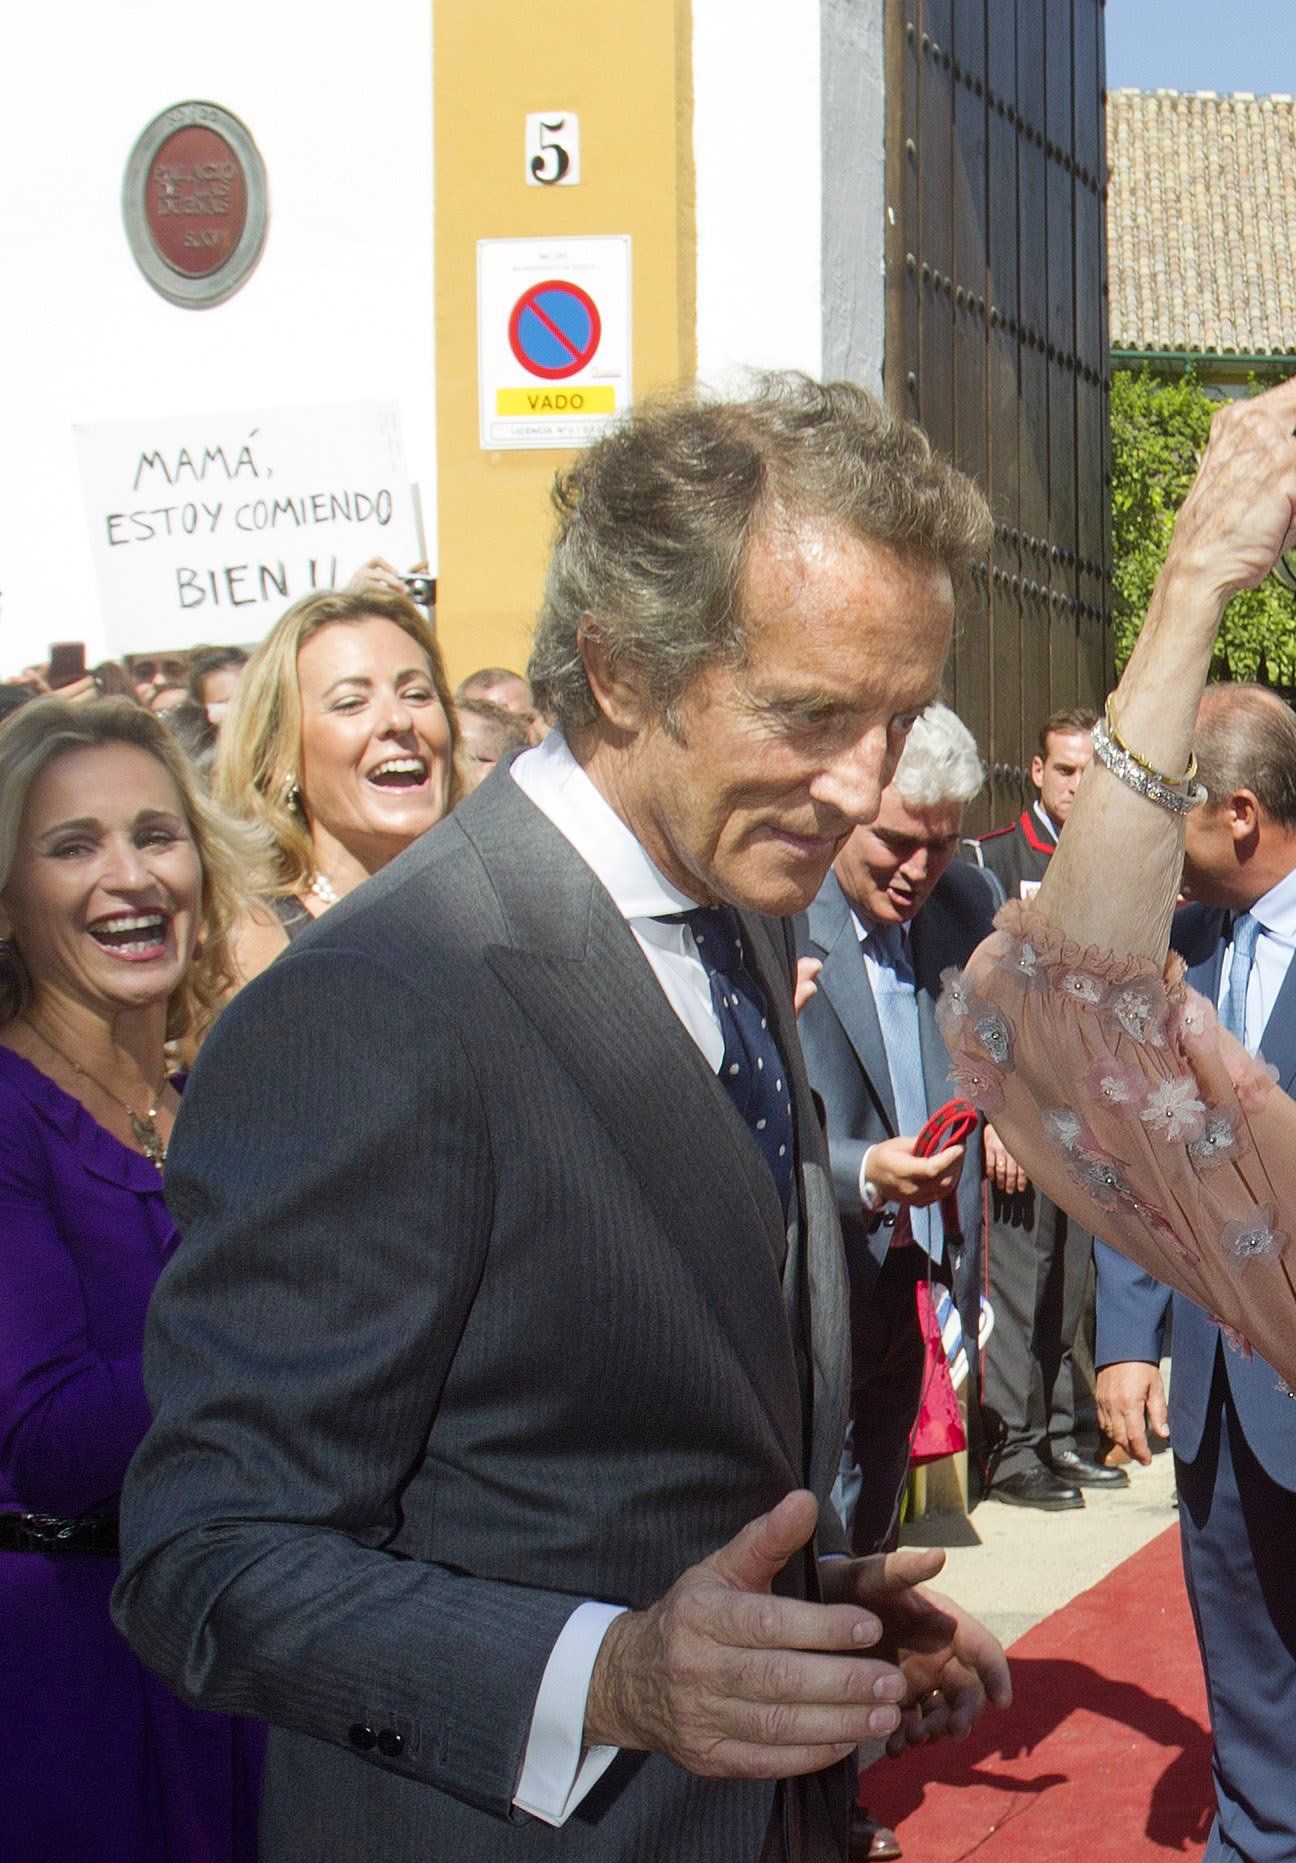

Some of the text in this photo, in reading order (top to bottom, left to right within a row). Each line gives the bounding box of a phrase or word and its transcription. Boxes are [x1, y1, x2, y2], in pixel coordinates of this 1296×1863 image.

[531, 119, 569, 185] 5
[527, 394, 584, 410] VADO
[133, 428, 273, 491] MAMÁ,
[106, 489, 392, 546] ESTOY COMIENDO
